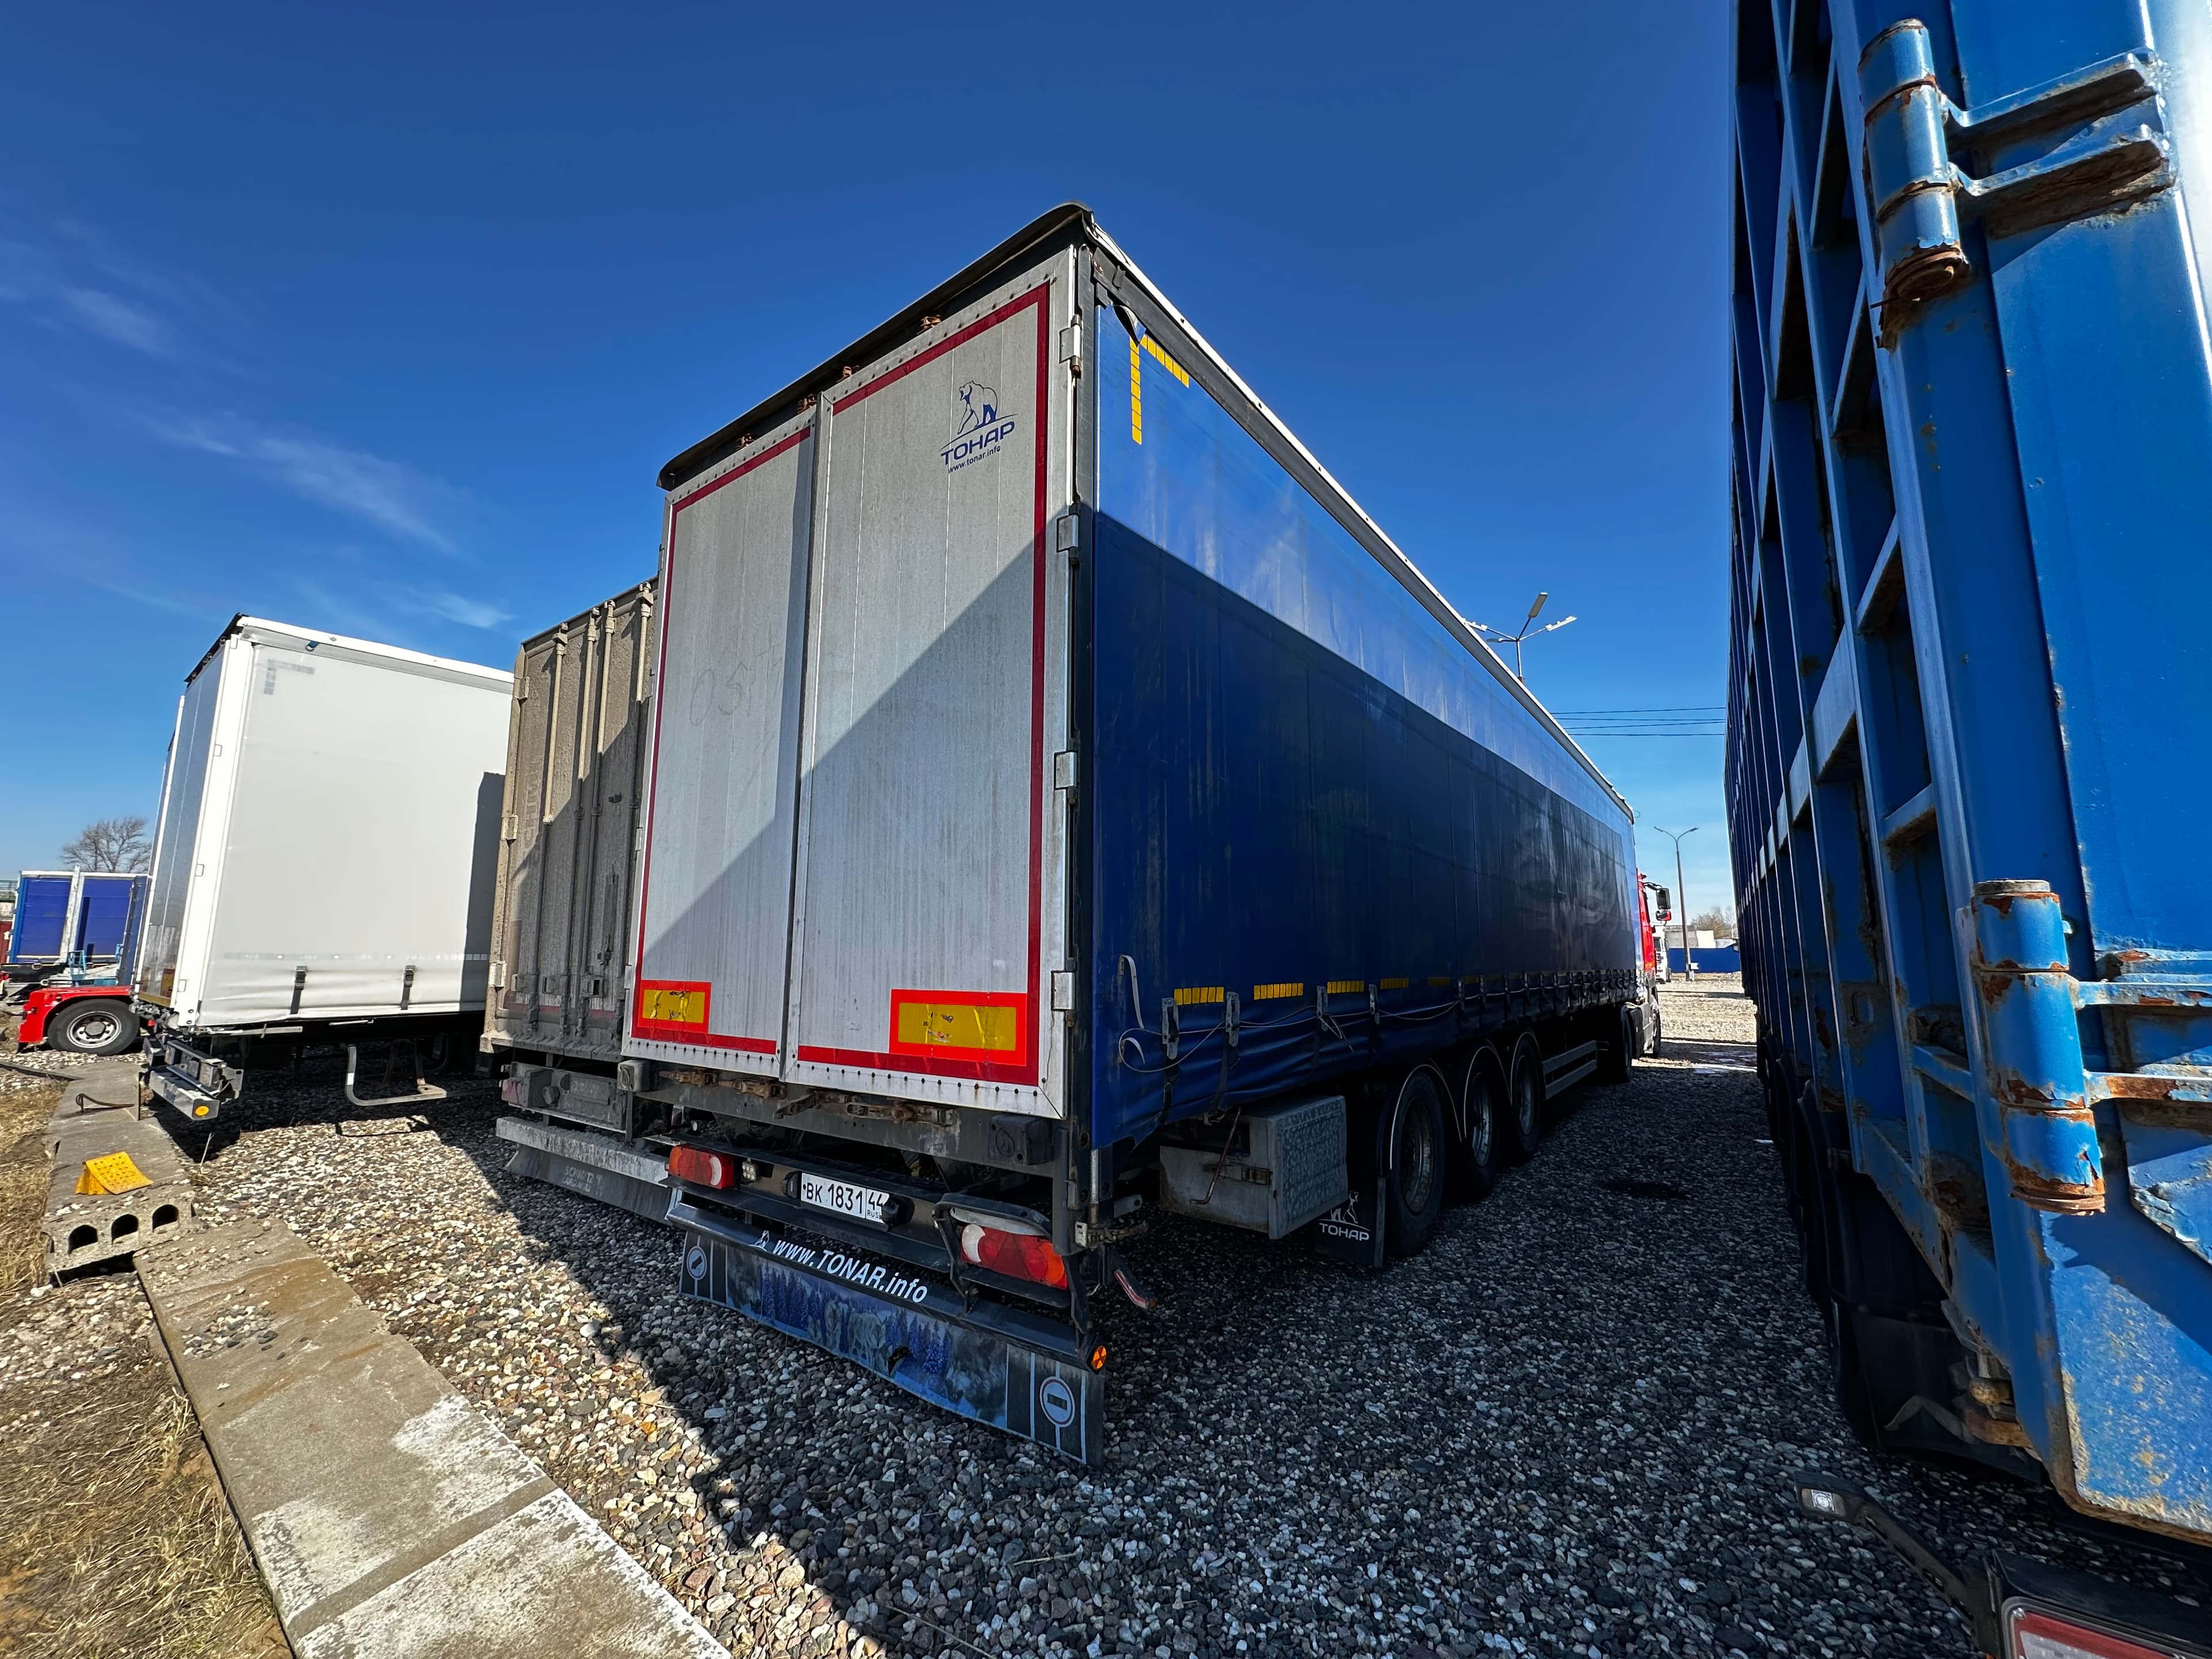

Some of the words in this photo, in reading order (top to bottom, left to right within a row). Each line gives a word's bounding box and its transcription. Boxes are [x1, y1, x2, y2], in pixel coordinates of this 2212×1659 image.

[941, 421, 1015, 465] ТОНАР
[948, 445, 1001, 474] www.tonar.info
[827, 1183, 863, 1214] 1831
[867, 1209, 880, 1219] RUS
[1319, 1222, 1370, 1241] ТОНАР
[772, 1240, 928, 1303] www.TONAR.info
